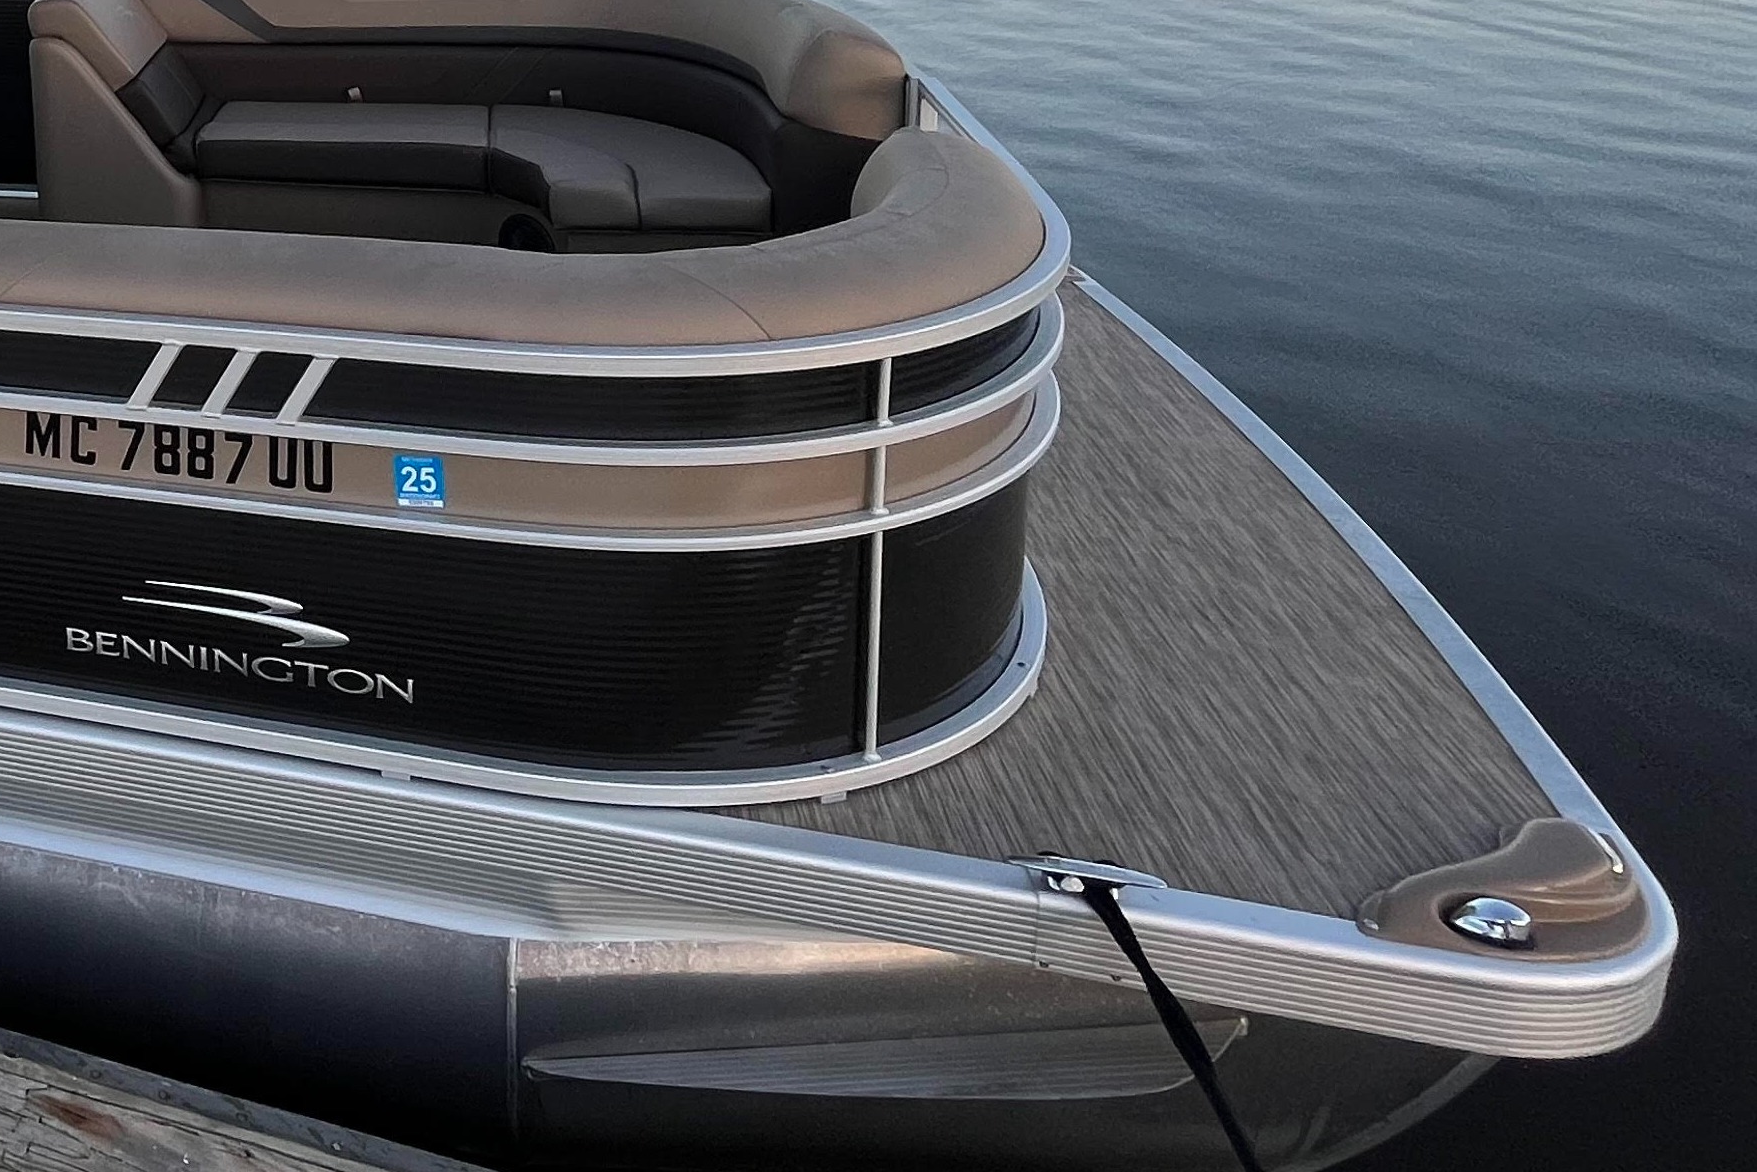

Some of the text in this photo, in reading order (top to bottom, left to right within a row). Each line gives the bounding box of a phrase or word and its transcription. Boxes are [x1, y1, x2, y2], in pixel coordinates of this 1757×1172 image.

[25, 411, 98, 465] MC
[117, 420, 253, 484] 7887
[400, 465, 437, 493] 25
[65, 626, 415, 704] BENNINGTON
